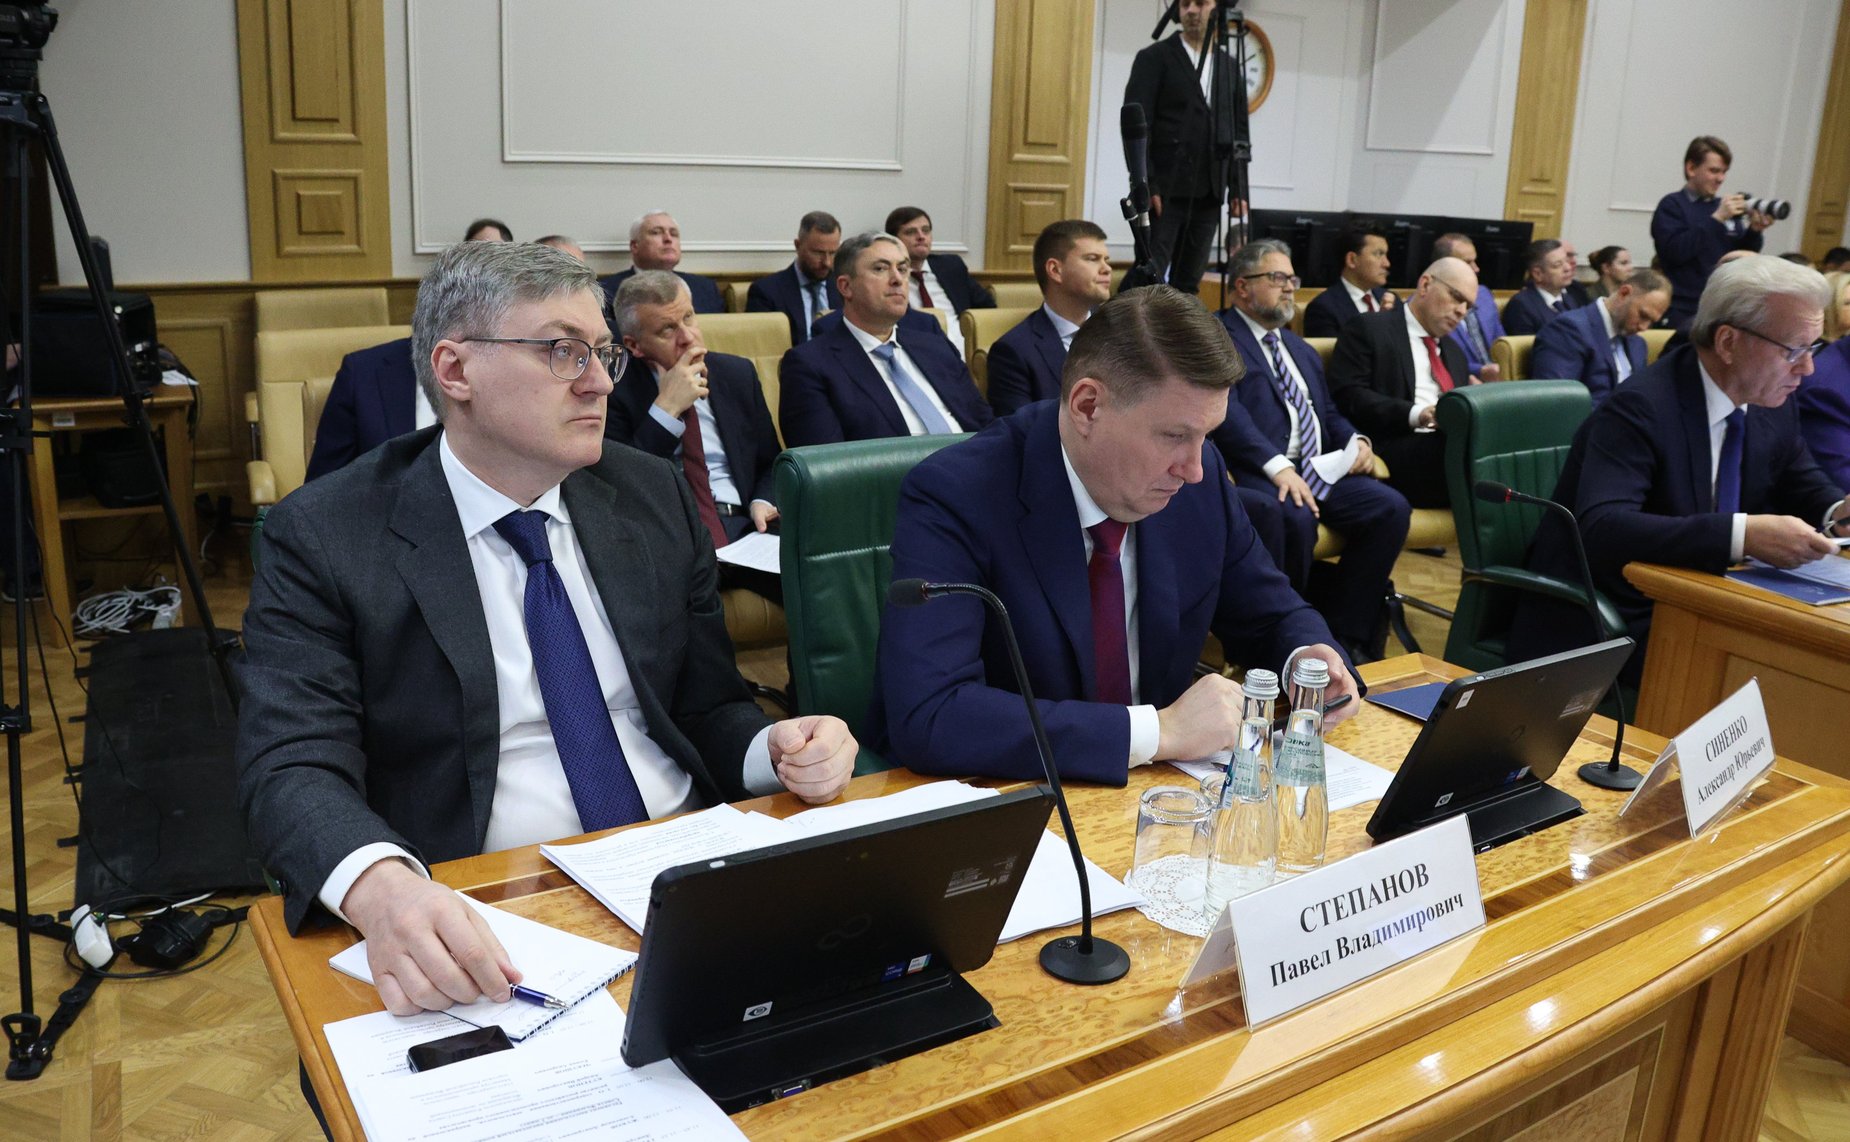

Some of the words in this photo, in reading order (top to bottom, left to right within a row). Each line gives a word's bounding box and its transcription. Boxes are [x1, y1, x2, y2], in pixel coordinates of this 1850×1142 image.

[1697, 762, 1736, 805] Александр
[1736, 737, 1766, 773] Юрьевич
[1705, 715, 1749, 762] СИНЕНКО
[1300, 863, 1430, 933] СТЕПАНОВ
[1269, 950, 1331, 988] Павел
[1336, 893, 1464, 961] Владимирович
